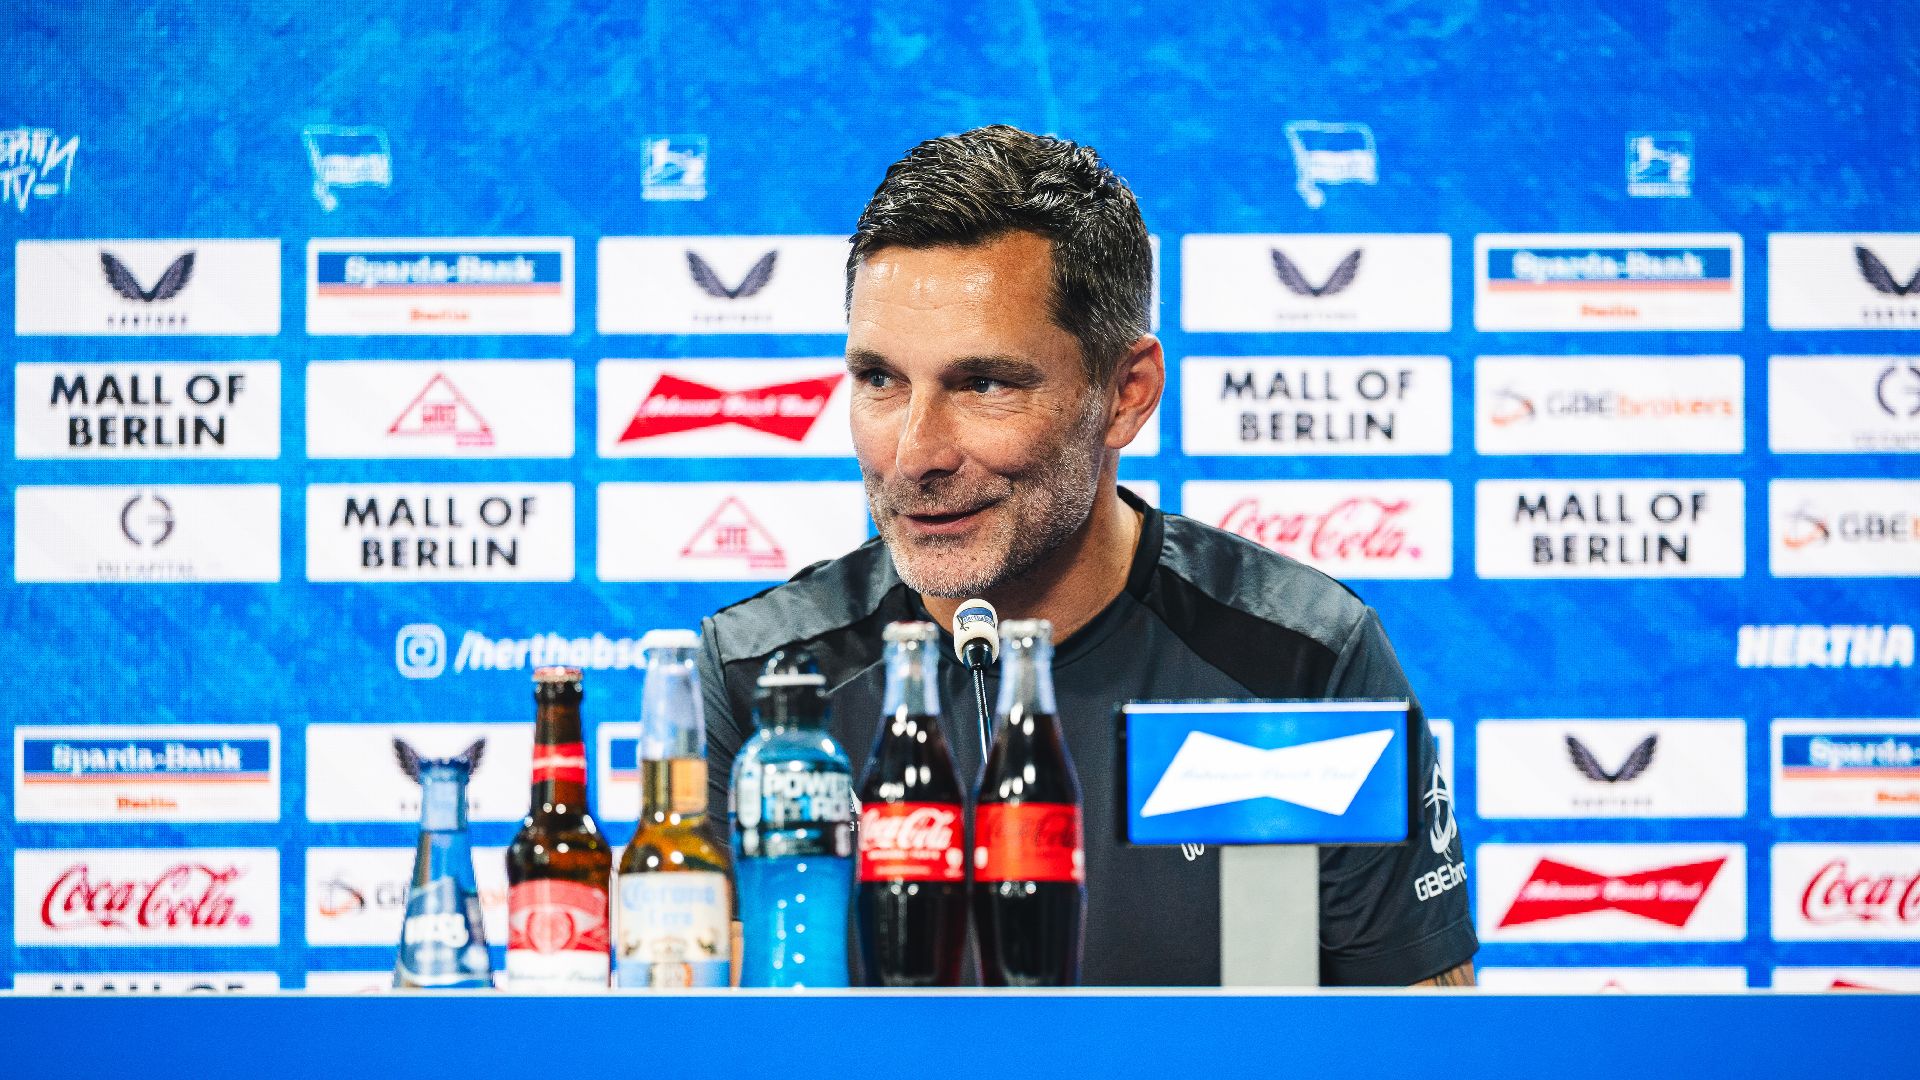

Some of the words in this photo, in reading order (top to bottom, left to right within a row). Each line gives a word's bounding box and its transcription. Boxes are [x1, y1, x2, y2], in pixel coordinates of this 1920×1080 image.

[50, 374, 171, 407] MALL
[185, 374, 246, 407] OF
[1222, 370, 1342, 401] MALL
[1356, 370, 1414, 401] OF
[68, 415, 225, 448] BERLIN
[1239, 412, 1396, 443] BERLIN
[344, 496, 462, 528] MALL
[479, 496, 537, 528] OF
[1515, 493, 1634, 524] MALL
[1650, 493, 1707, 524] OF
[362, 538, 518, 569] BERLIN
[1532, 535, 1689, 566] BERLIN
[1738, 625, 1915, 668] HERTHA
